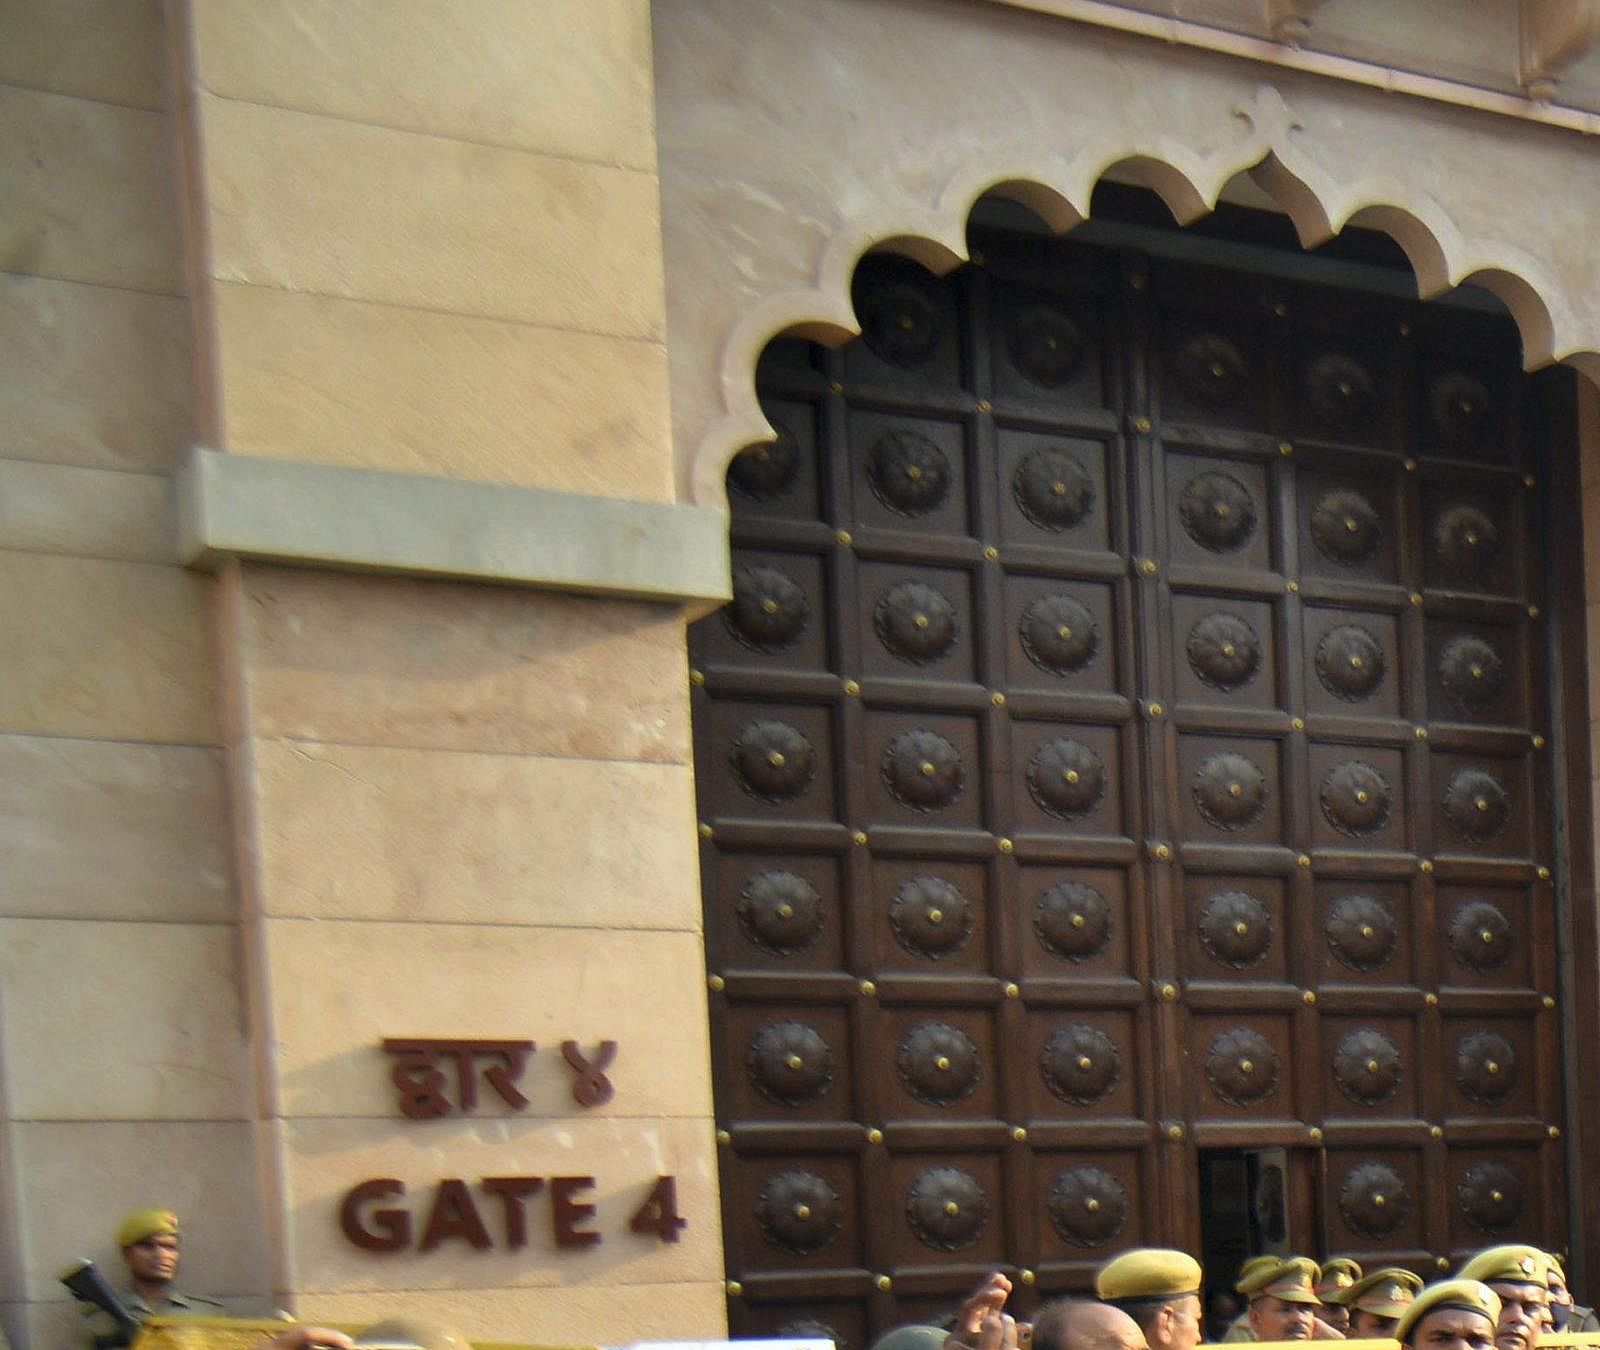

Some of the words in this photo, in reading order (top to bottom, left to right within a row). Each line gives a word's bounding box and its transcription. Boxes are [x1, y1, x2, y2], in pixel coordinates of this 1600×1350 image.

[381, 1037, 535, 1119] द्वार
[341, 1176, 601, 1253] GATE
[629, 1175, 687, 1244] 4
